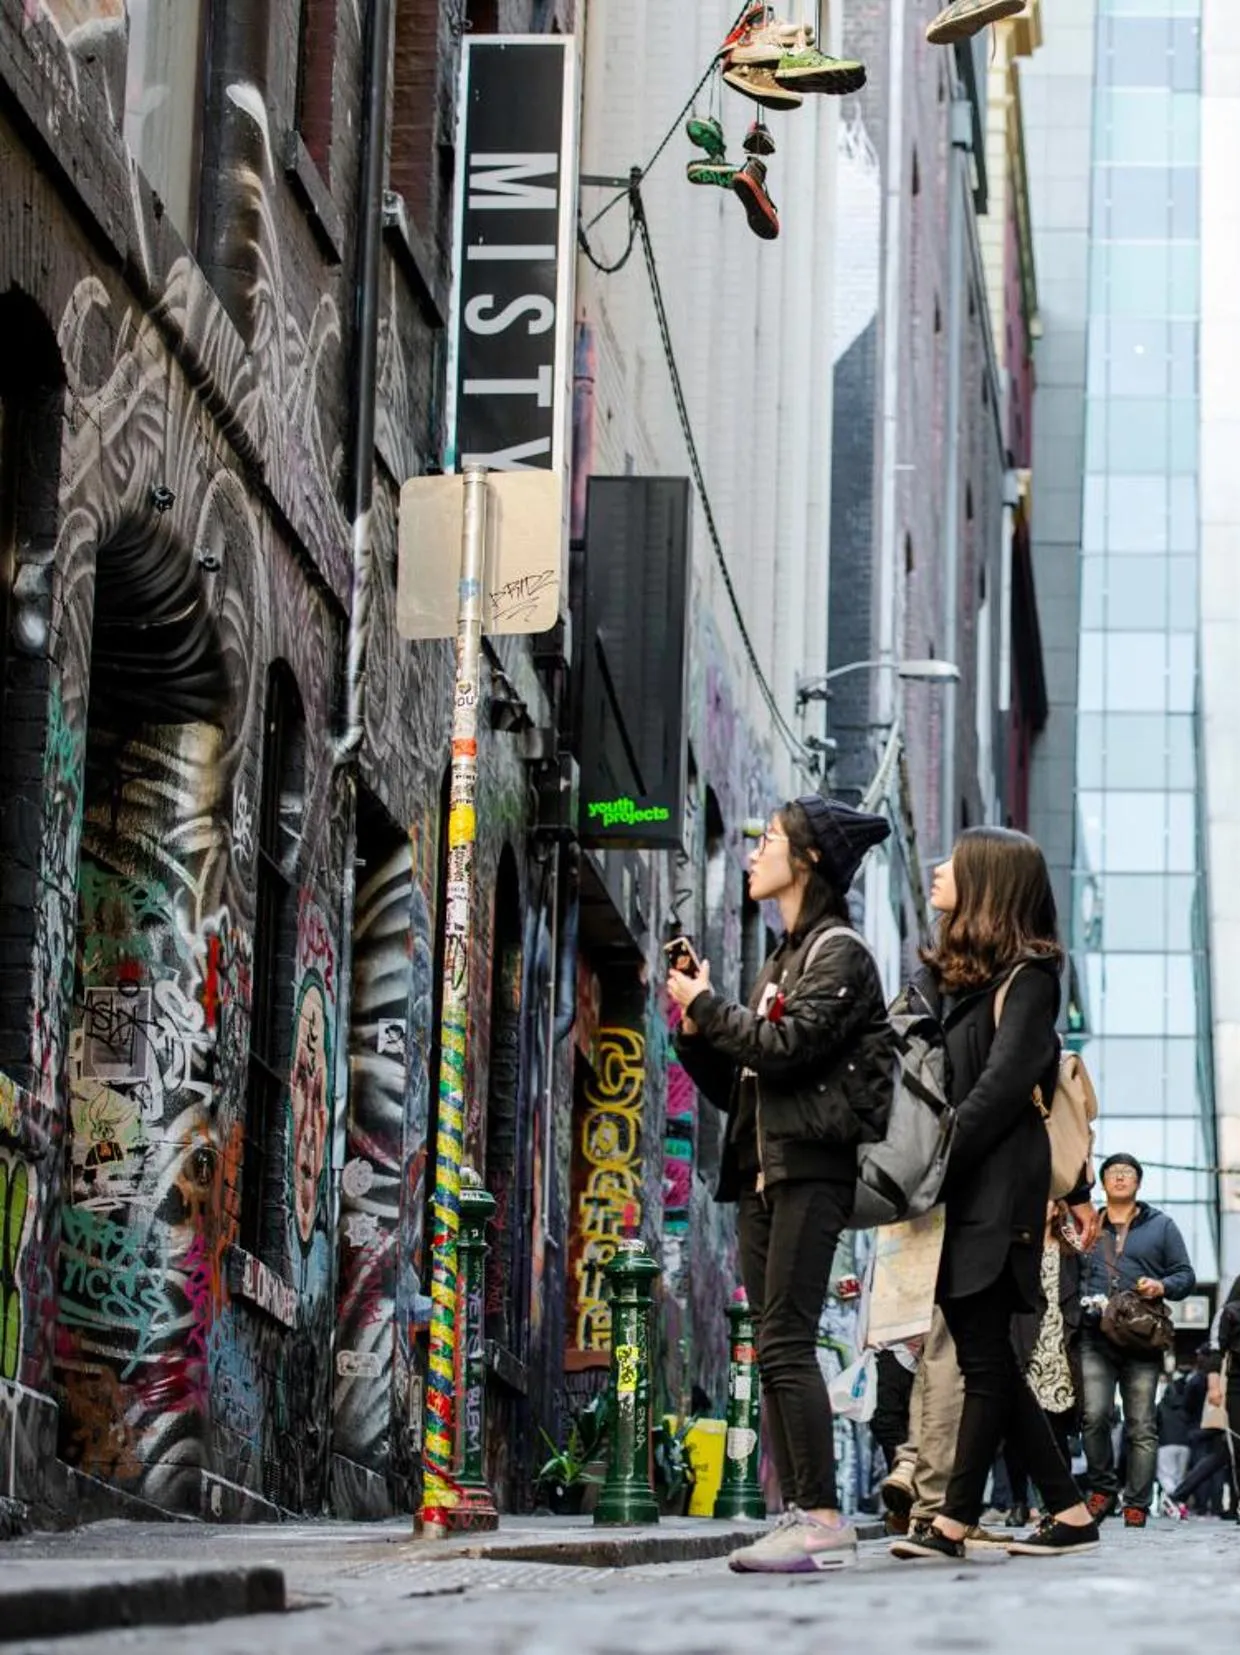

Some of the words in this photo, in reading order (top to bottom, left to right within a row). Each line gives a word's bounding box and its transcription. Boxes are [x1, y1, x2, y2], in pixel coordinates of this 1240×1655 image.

[462, 152, 558, 472] MISTY
[588, 795, 635, 817] youth
[603, 806, 670, 827] projects
